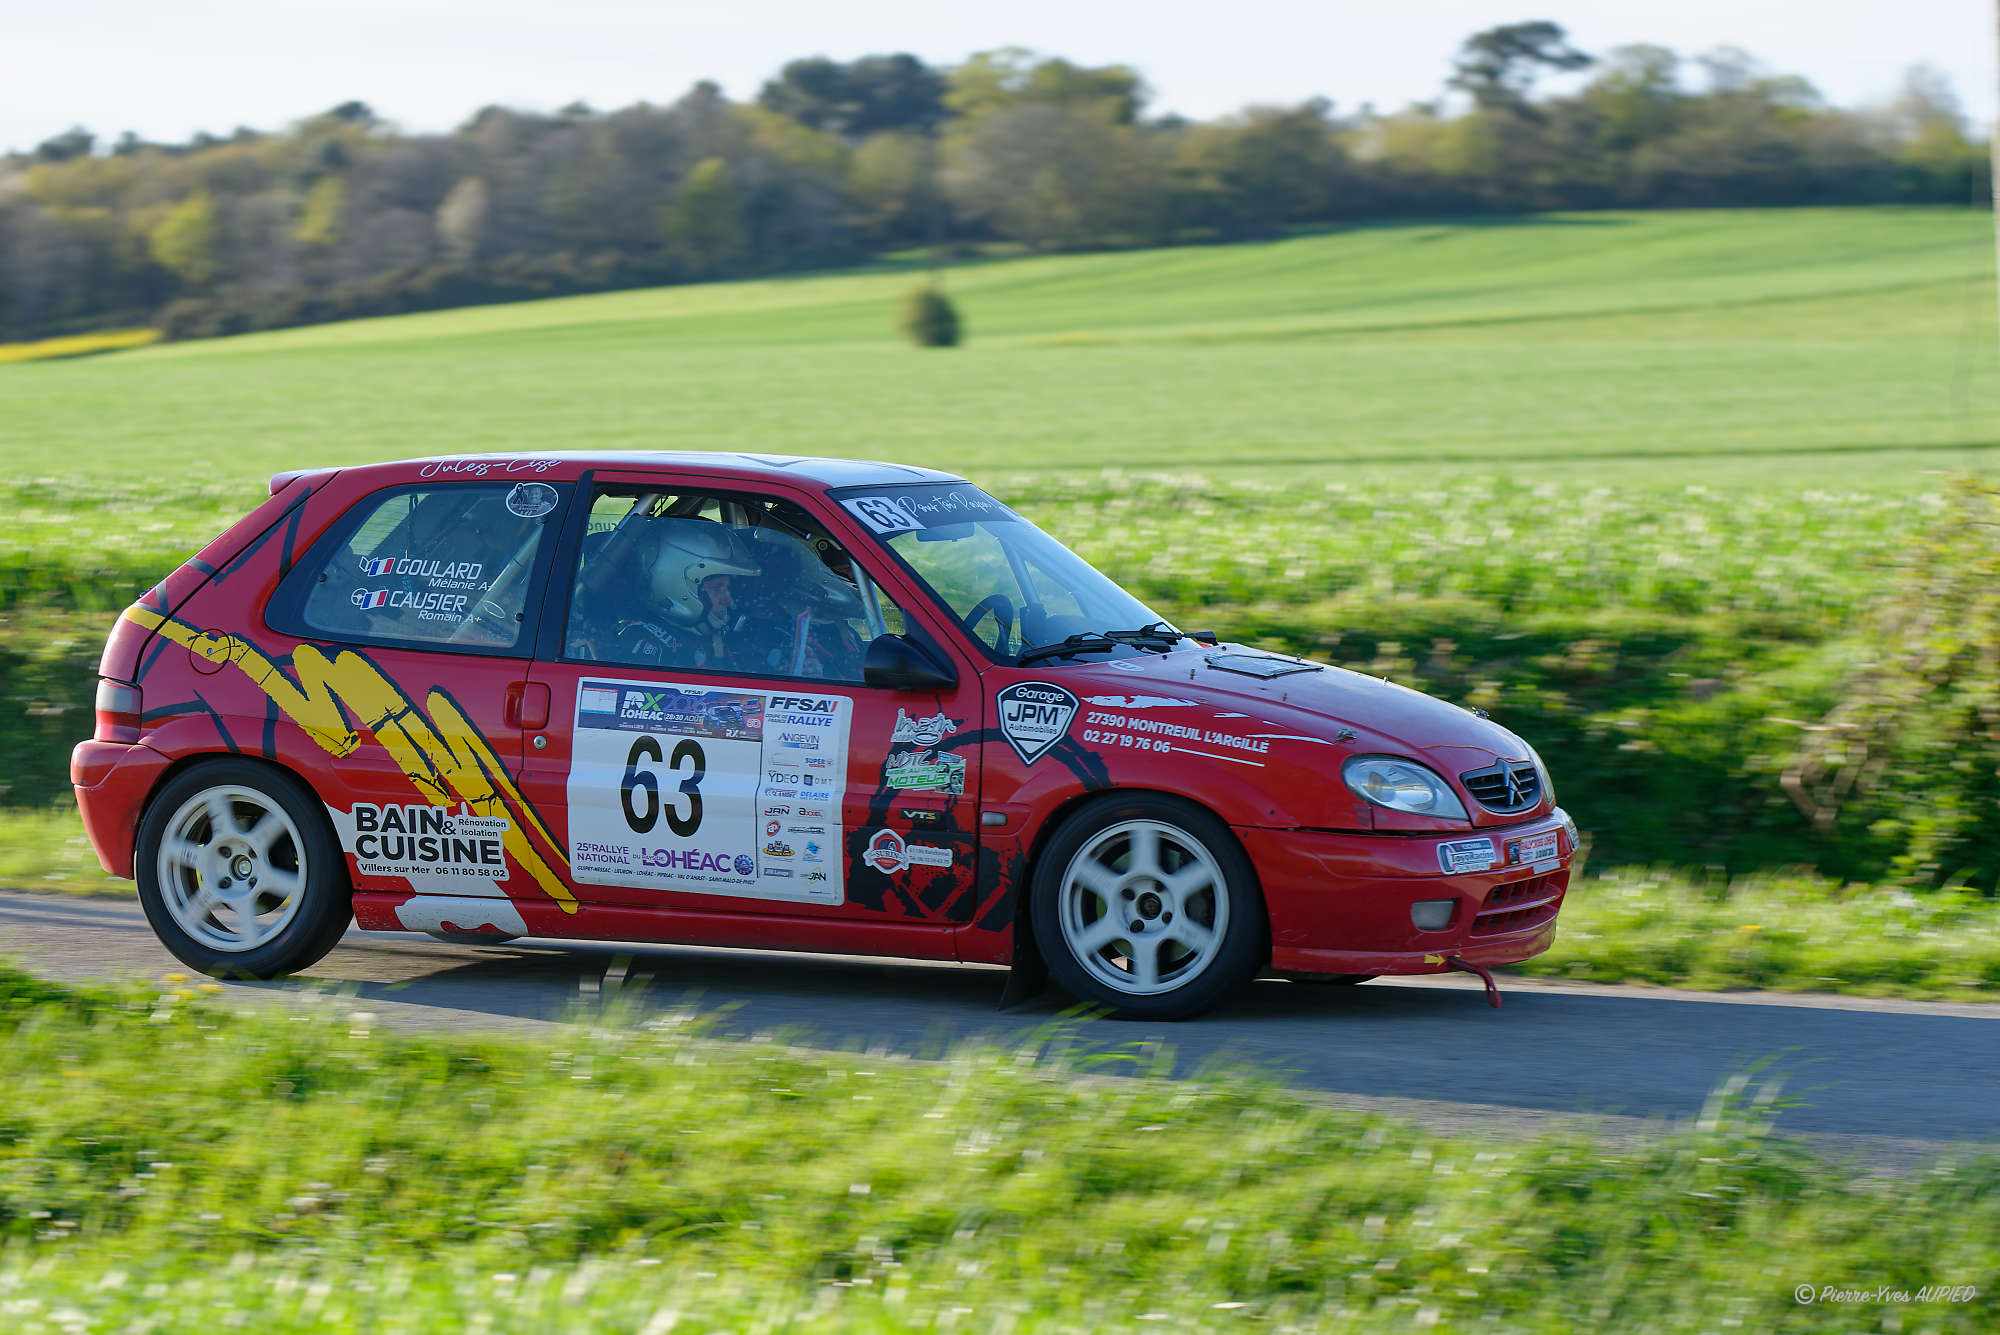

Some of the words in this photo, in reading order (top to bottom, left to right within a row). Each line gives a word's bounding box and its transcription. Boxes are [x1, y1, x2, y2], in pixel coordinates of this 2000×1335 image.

[856, 498, 912, 529] 63
[396, 558, 483, 580] GOULARD
[428, 577, 476, 590] Mélanie
[388, 590, 468, 612] CAUSIER
[417, 609, 462, 623] Romain
[1015, 686, 1065, 703] Garage
[769, 696, 829, 713] FFSA
[620, 709, 663, 721] LOHEAC
[787, 715, 833, 727] RALLYE
[1007, 702, 1059, 726] JPM
[1009, 723, 1059, 735] Automobiles
[1086, 711, 1126, 728] 27390
[1127, 717, 1203, 741] MONTREUIL
[1204, 730, 1270, 754] L'ARGILLÉ
[778, 732, 820, 744] ANGEVIN
[1083, 728, 1100, 742] 02
[1101, 731, 1118, 745] 27
[1119, 734, 1133, 747] 19
[1134, 737, 1151, 750] 76
[1152, 739, 1172, 753] 06
[620, 735, 706, 838] 63
[888, 773, 947, 787] MOTEUR
[355, 806, 444, 835] BAIN
[441, 820, 457, 836] &
[458, 817, 507, 828] Rénovation
[903, 810, 937, 820] VTS
[461, 828, 498, 838] Isolation
[355, 834, 503, 865] CUISINE
[591, 844, 629, 855] RALLYE
[577, 852, 631, 865] NATIONAL
[642, 847, 731, 873] LOHÉAC
[361, 862, 392, 873] Villers
[394, 865, 410, 874] sur
[411, 865, 431, 874] Mer
[435, 866, 449, 875] 06
[451, 867, 461, 876] 11
[462, 867, 476, 876] 80
[477, 867, 491, 877] 58
[492, 869, 507, 878] 02
